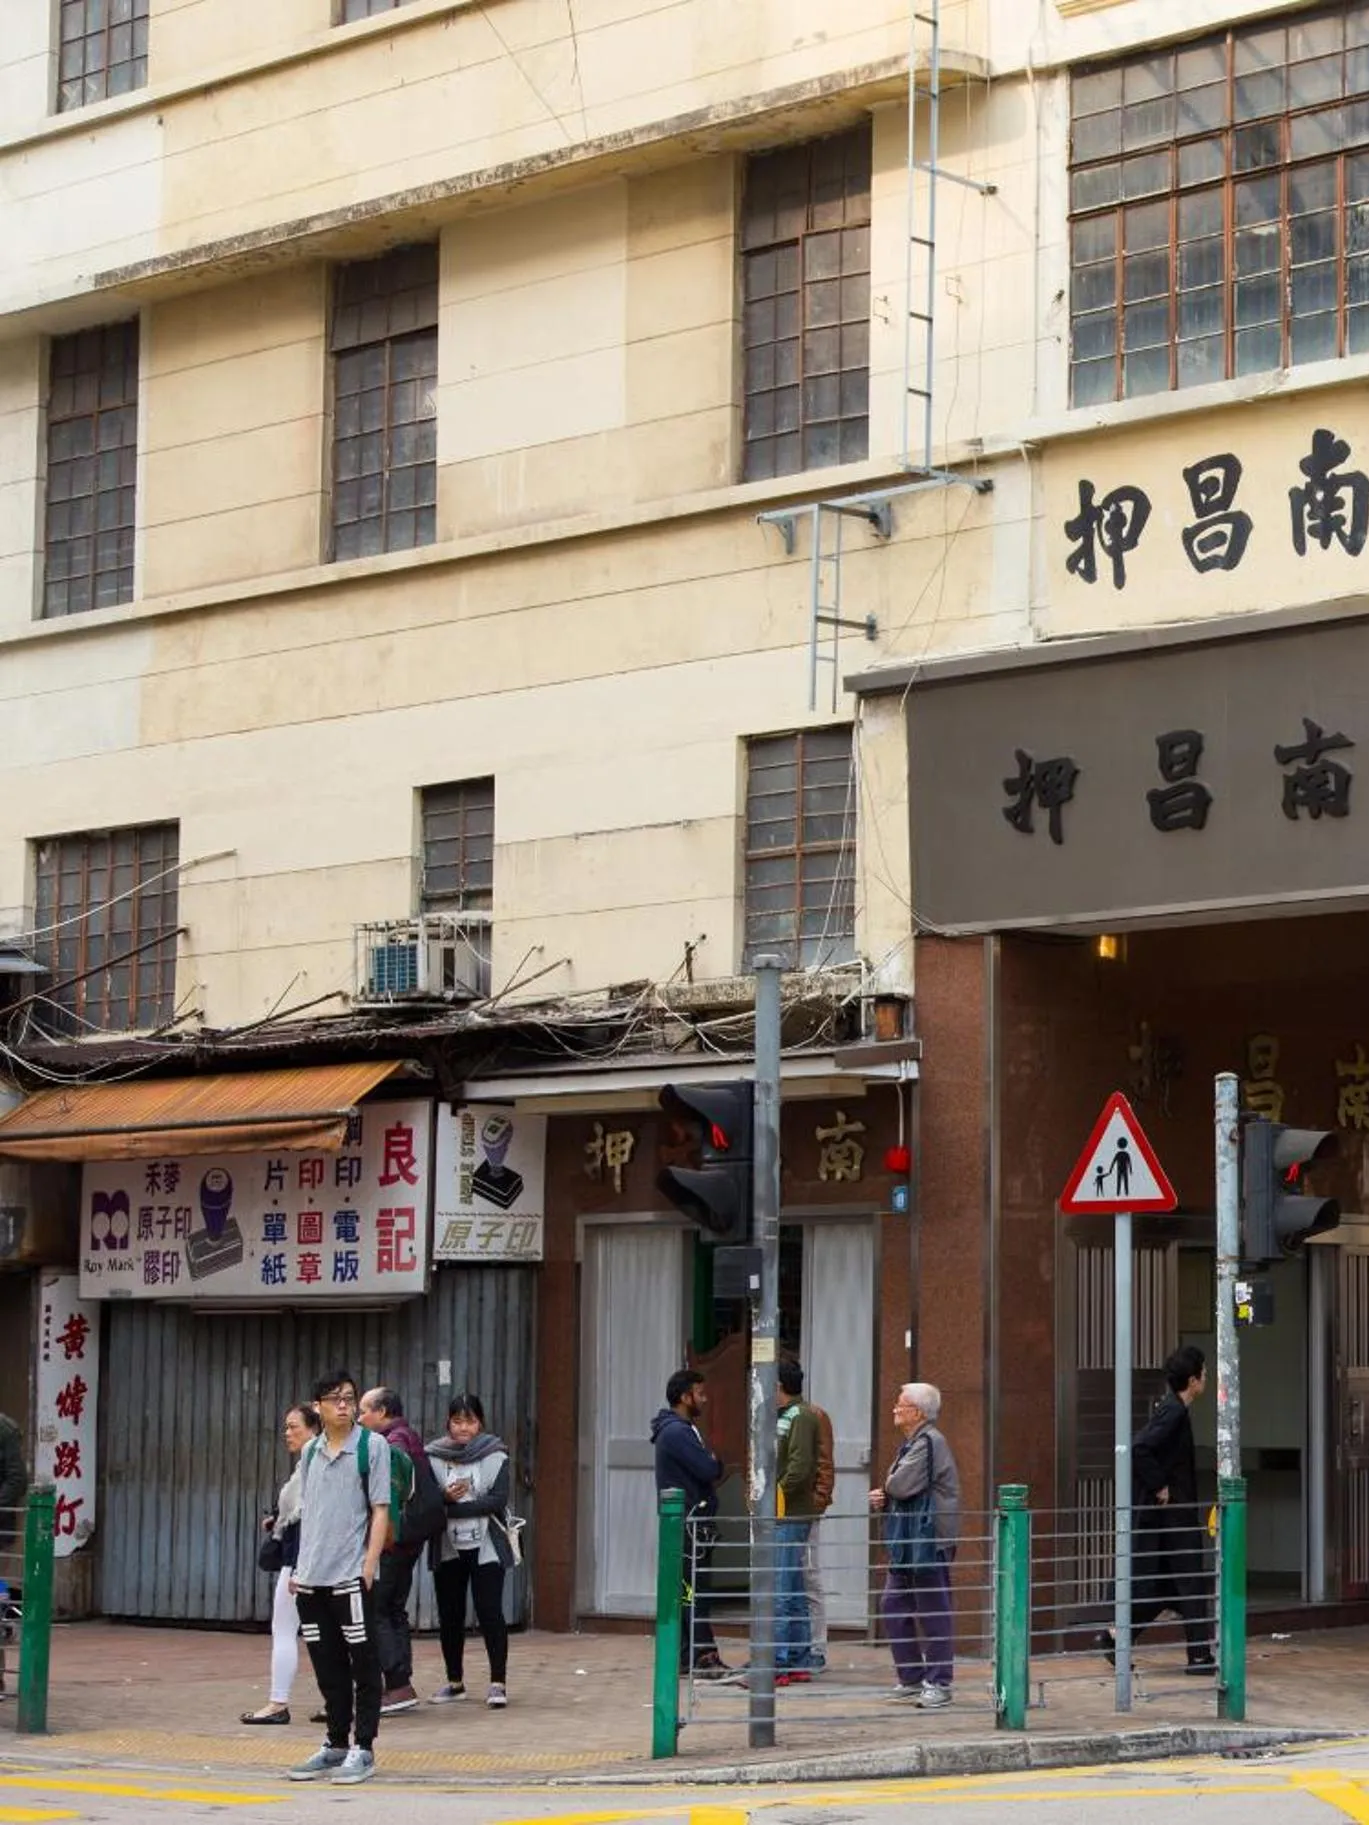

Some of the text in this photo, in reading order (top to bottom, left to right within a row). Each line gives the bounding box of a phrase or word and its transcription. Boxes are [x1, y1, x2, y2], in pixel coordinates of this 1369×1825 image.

[375, 1120, 419, 1275] 良記
[136, 1205, 192, 1241] 原子印
[439, 1219, 538, 1251] 原子印
